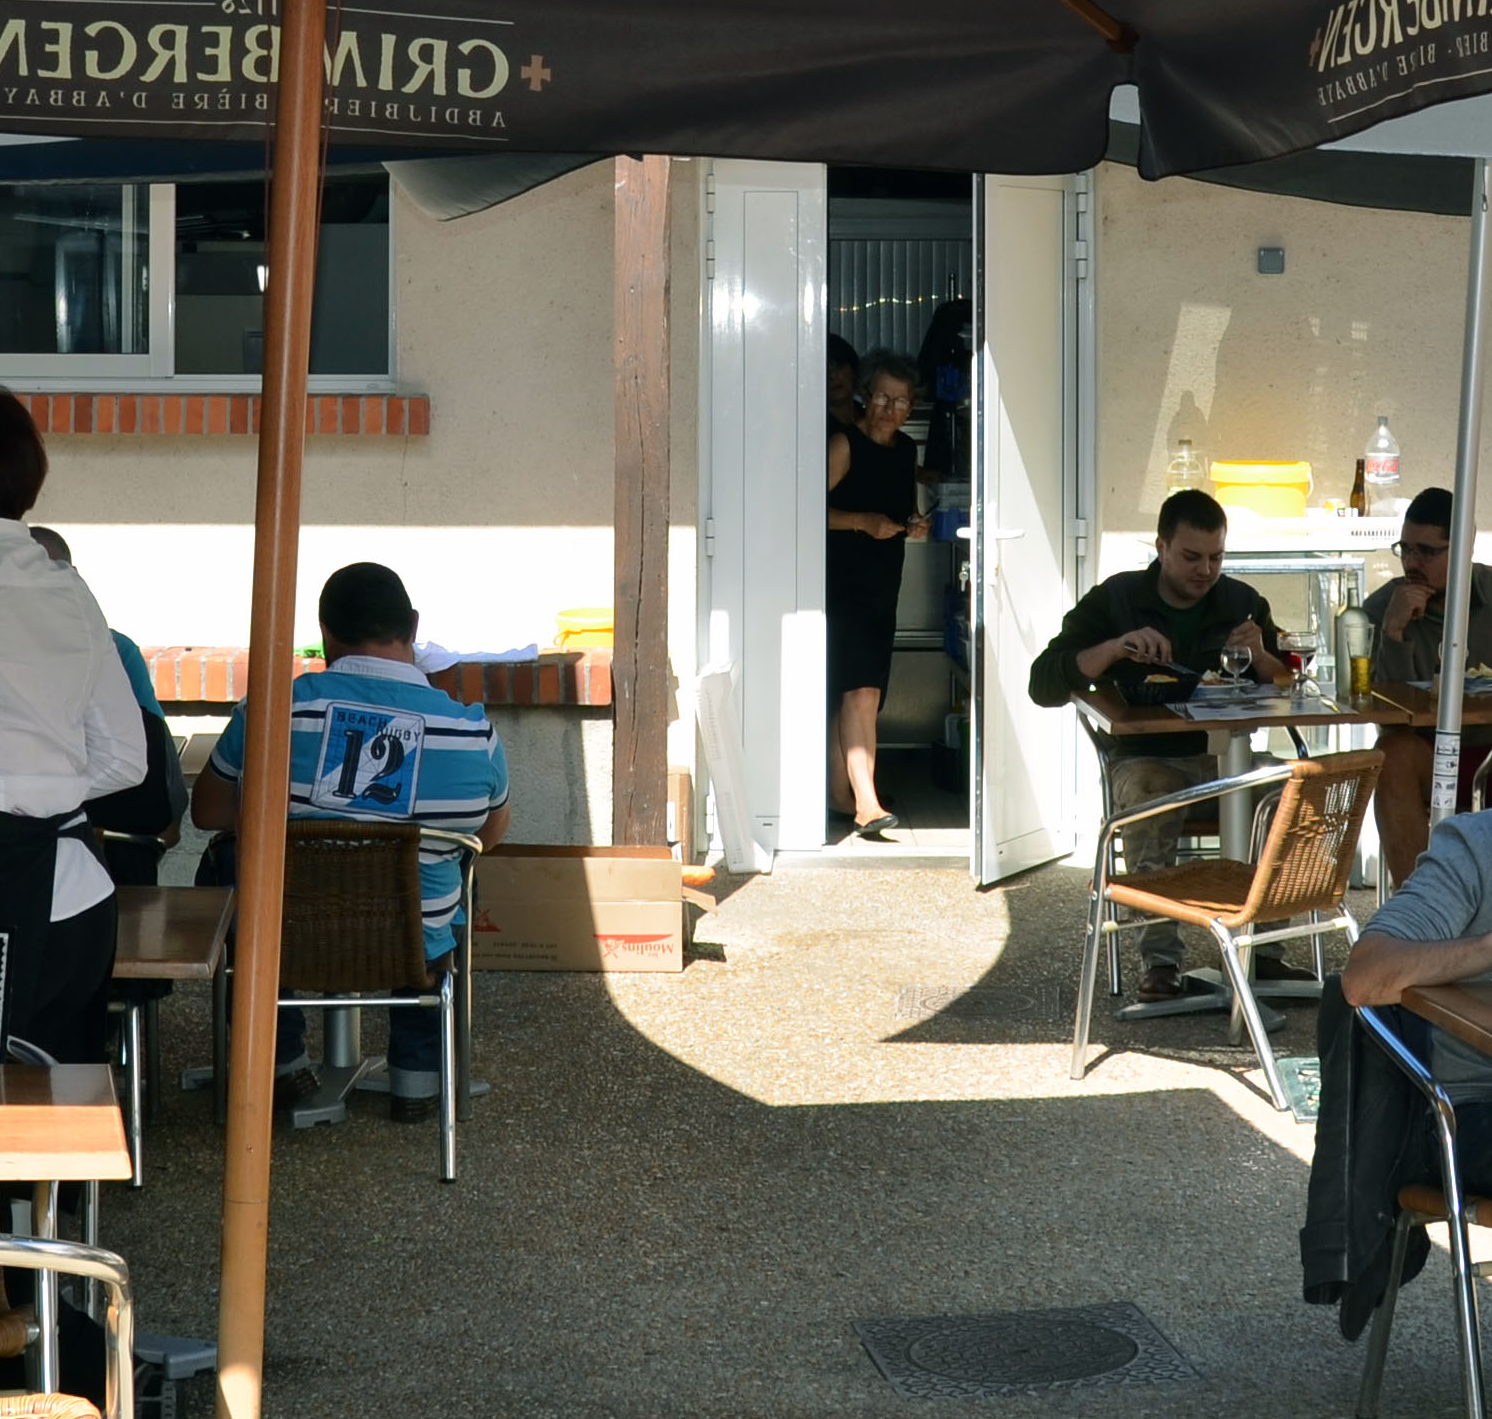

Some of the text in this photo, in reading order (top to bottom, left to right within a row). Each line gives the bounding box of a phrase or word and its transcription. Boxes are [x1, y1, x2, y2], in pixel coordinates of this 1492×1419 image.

[337, 711, 388, 728] BEACH
[377, 725, 421, 741] RUGBY
[332, 729, 405, 805] 12
[621, 943, 674, 955] Moulins
